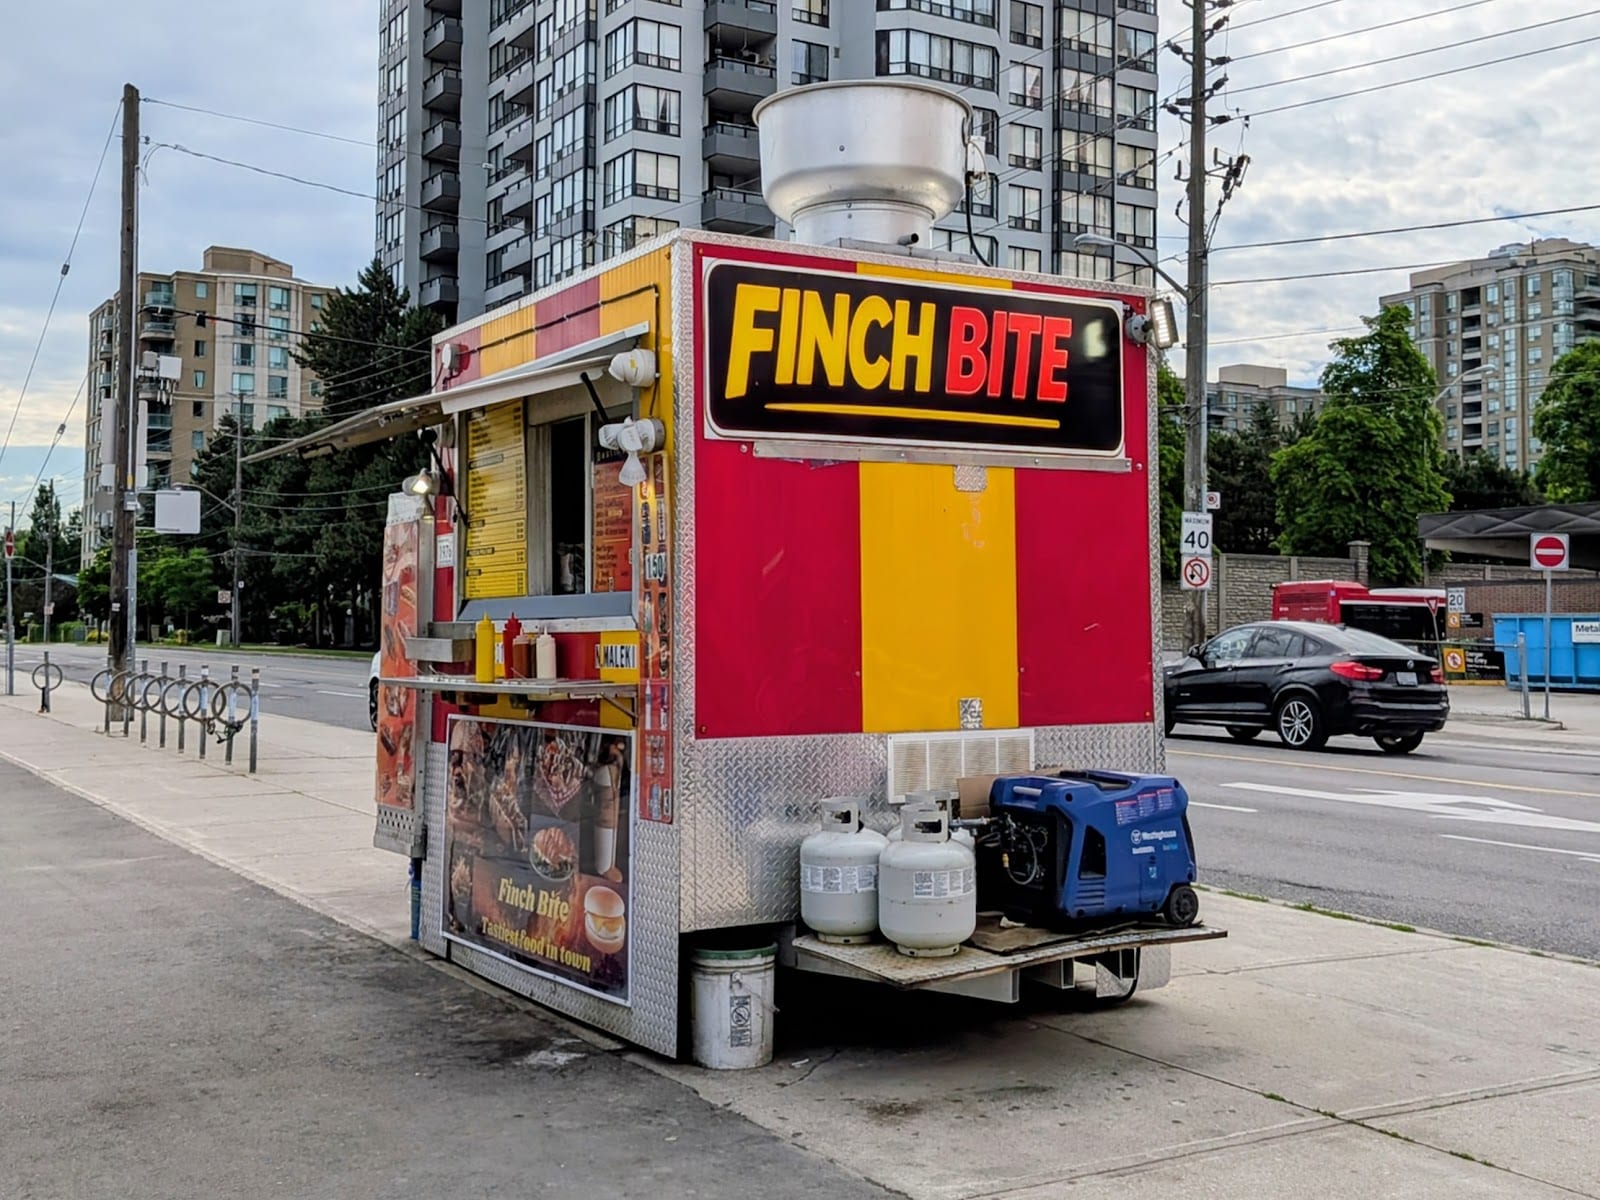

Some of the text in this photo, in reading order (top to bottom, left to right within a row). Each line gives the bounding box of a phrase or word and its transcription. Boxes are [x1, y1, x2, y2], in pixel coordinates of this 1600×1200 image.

[725, 283, 1073, 402] FINCH BITE
[1184, 530, 1210, 549] 40
[1449, 594, 1464, 606] 20
[498, 878, 569, 922] Finch Bite
[481, 916, 591, 973] Tastiest food in town
